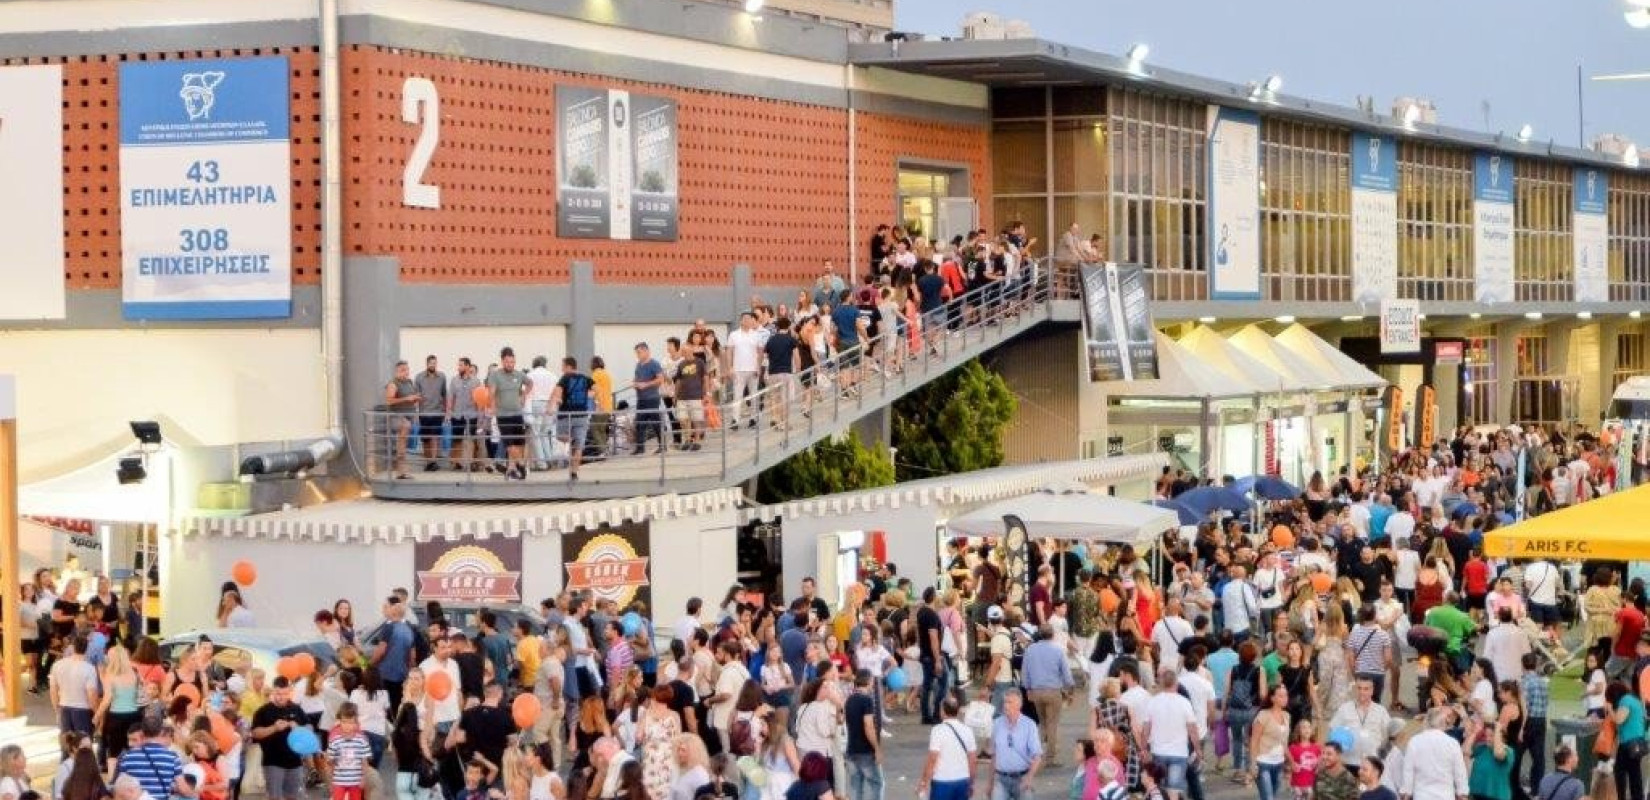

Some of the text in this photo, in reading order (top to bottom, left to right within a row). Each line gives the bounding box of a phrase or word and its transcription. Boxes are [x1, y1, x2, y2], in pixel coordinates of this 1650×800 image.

[402, 77, 440, 209] 2
[186, 160, 220, 183] 43
[130, 186, 277, 207] ΕΠΙΜΕΛΗΤΗΡΙΑ
[179, 229, 229, 252] 308
[138, 255, 270, 275] ΕΠΙΧΕΙΡΗΣΕΙΣ
[1525, 540, 1592, 553] ARIS F.C.
